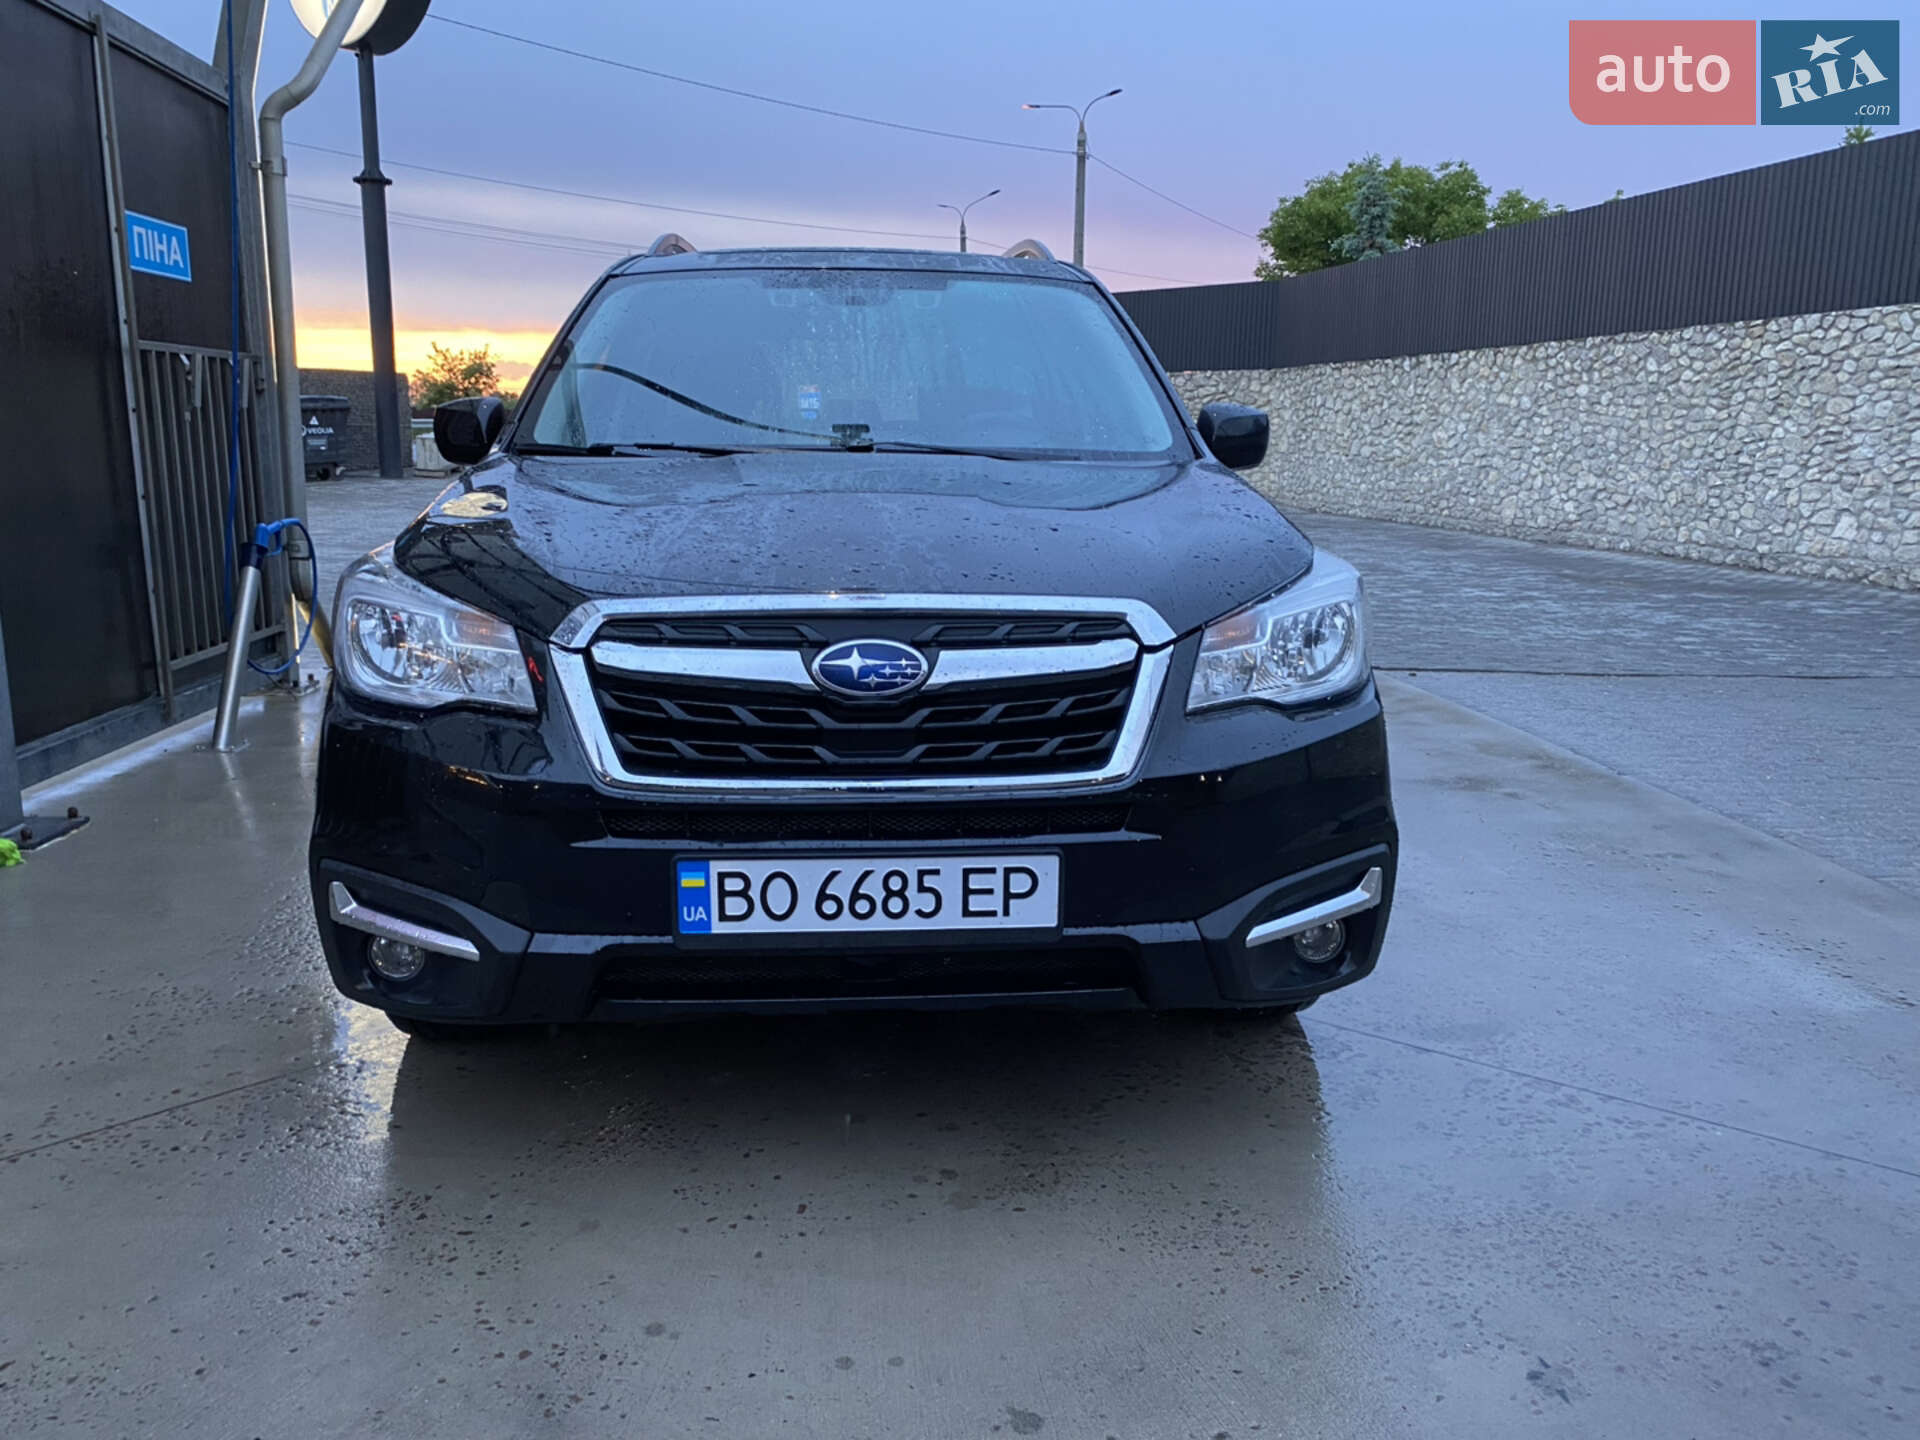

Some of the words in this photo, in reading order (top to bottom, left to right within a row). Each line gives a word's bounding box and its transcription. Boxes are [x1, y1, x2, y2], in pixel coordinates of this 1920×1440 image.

[132, 225, 184, 268] ПІНА
[683, 906, 708, 922] UA
[717, 870, 798, 922] BO
[814, 868, 943, 921] 6685
[961, 866, 1040, 918] EP
